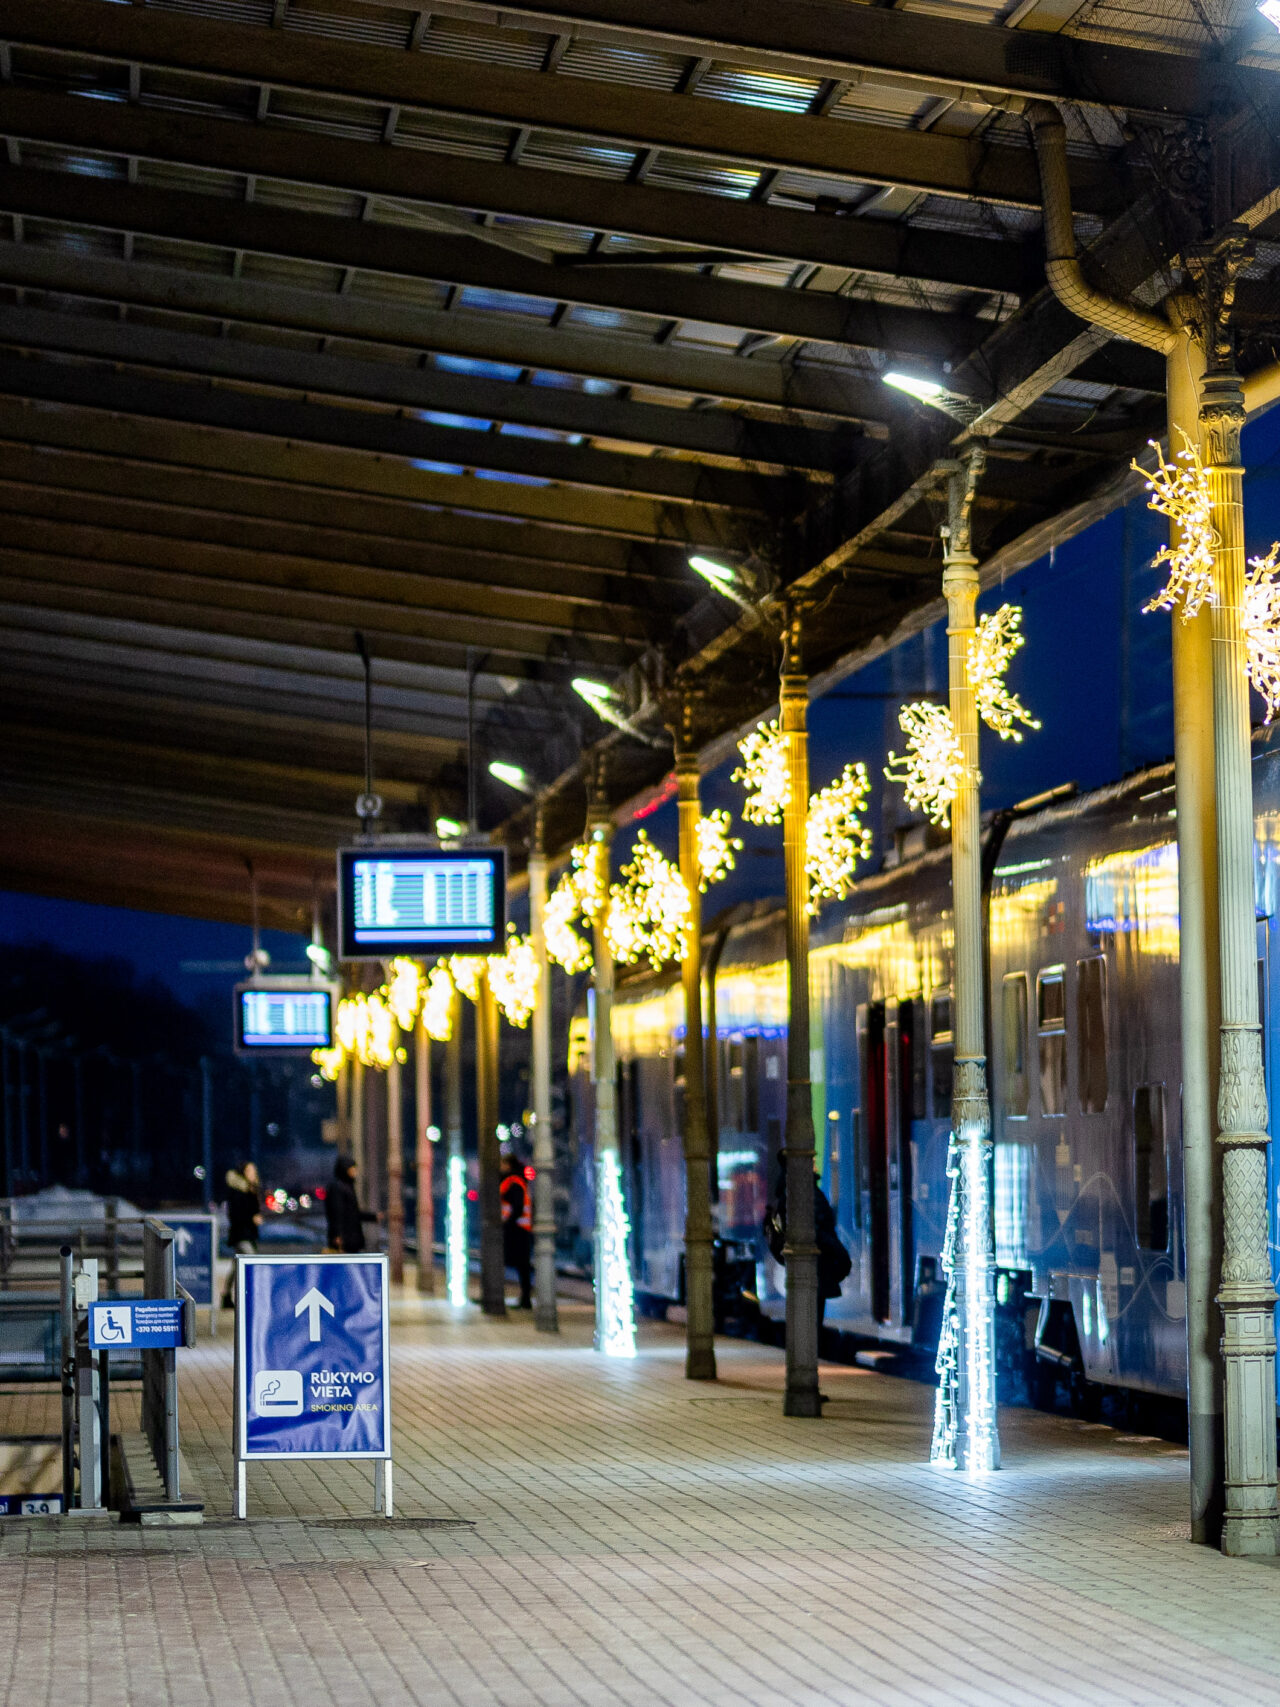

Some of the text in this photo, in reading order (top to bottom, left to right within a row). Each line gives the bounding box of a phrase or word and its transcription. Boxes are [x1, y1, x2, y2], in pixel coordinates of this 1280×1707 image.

[151, 1325, 162, 1333] 700
[311, 1370, 375, 1384] RŪKYMO
[310, 1386, 352, 1398] VIETA
[311, 1404, 354, 1412] SMOKING
